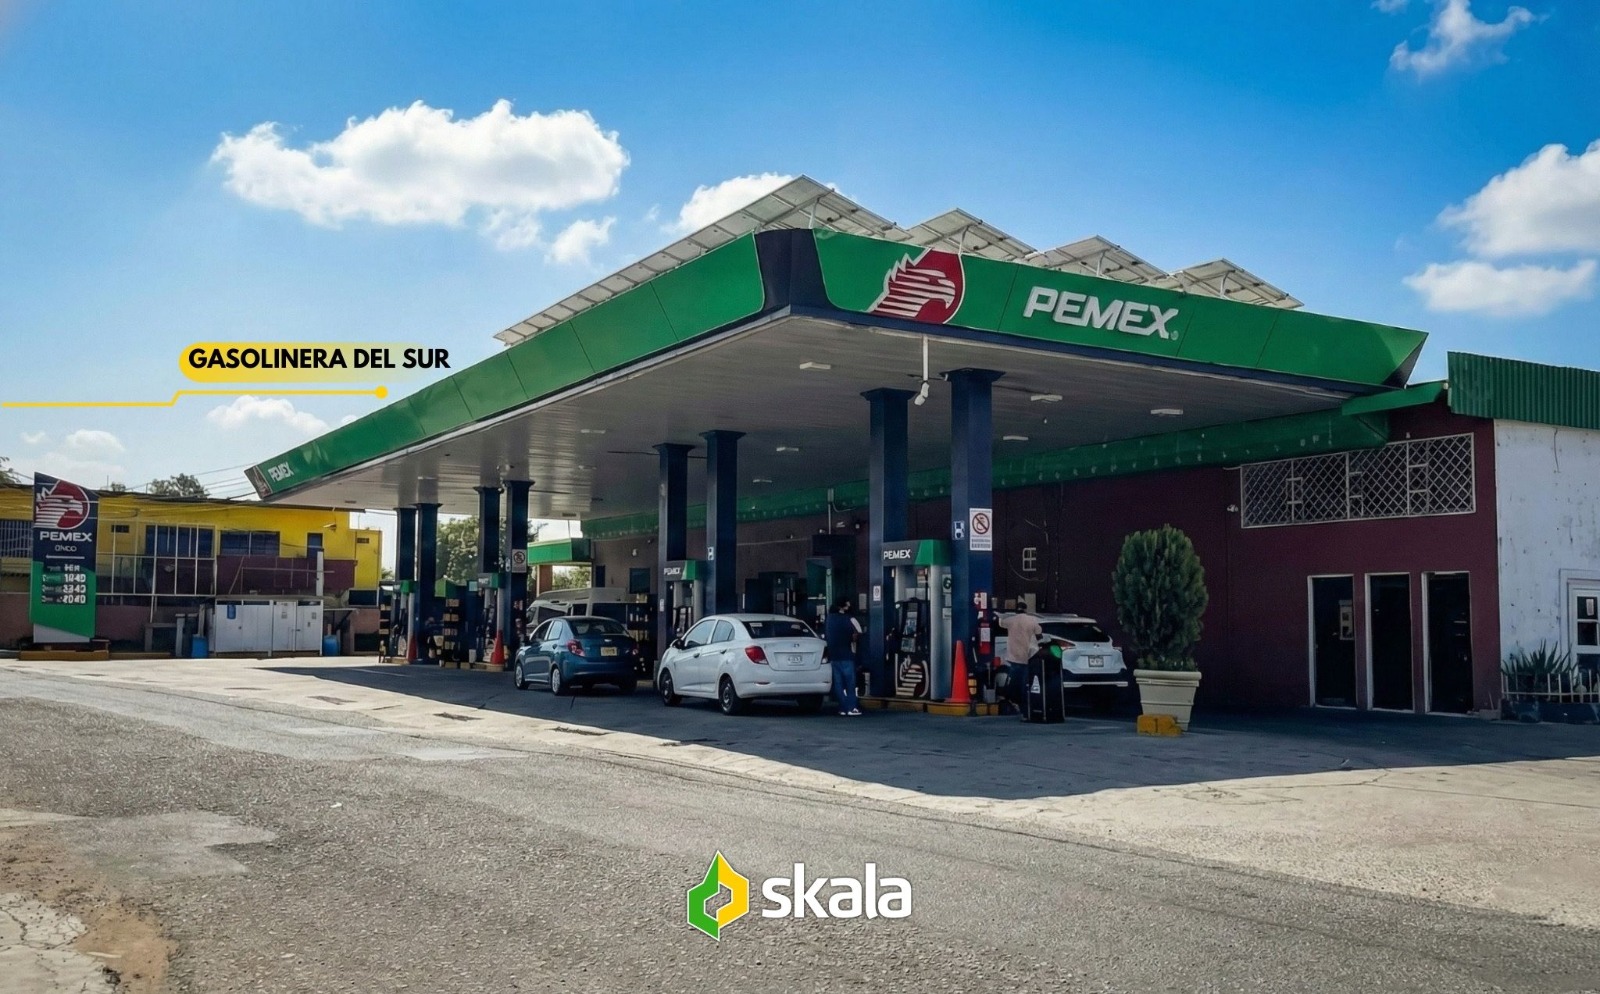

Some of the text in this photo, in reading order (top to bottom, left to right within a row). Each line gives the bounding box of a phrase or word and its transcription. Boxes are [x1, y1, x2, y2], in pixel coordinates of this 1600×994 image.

[1023, 286, 1178, 340] PEMEX
[40, 531, 92, 542] PEMEX
[883, 549, 911, 560] PEMEX
